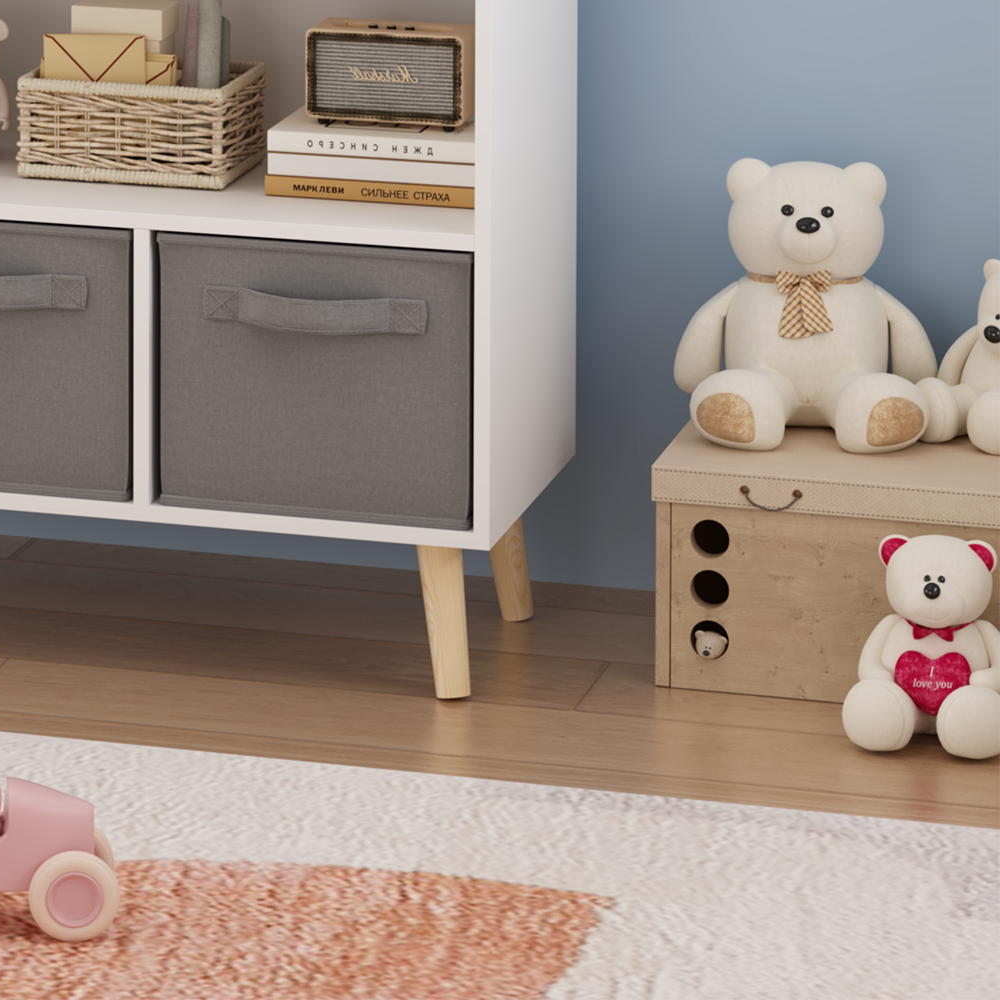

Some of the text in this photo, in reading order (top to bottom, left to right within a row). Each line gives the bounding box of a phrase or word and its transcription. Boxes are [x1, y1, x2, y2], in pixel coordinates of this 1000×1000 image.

[293, 184, 451, 202] МАРК ЛЕВИ СИЛЬНЕЕ СТРАХА
[929, 666, 935, 677] I
[912, 678, 953, 691] love you
